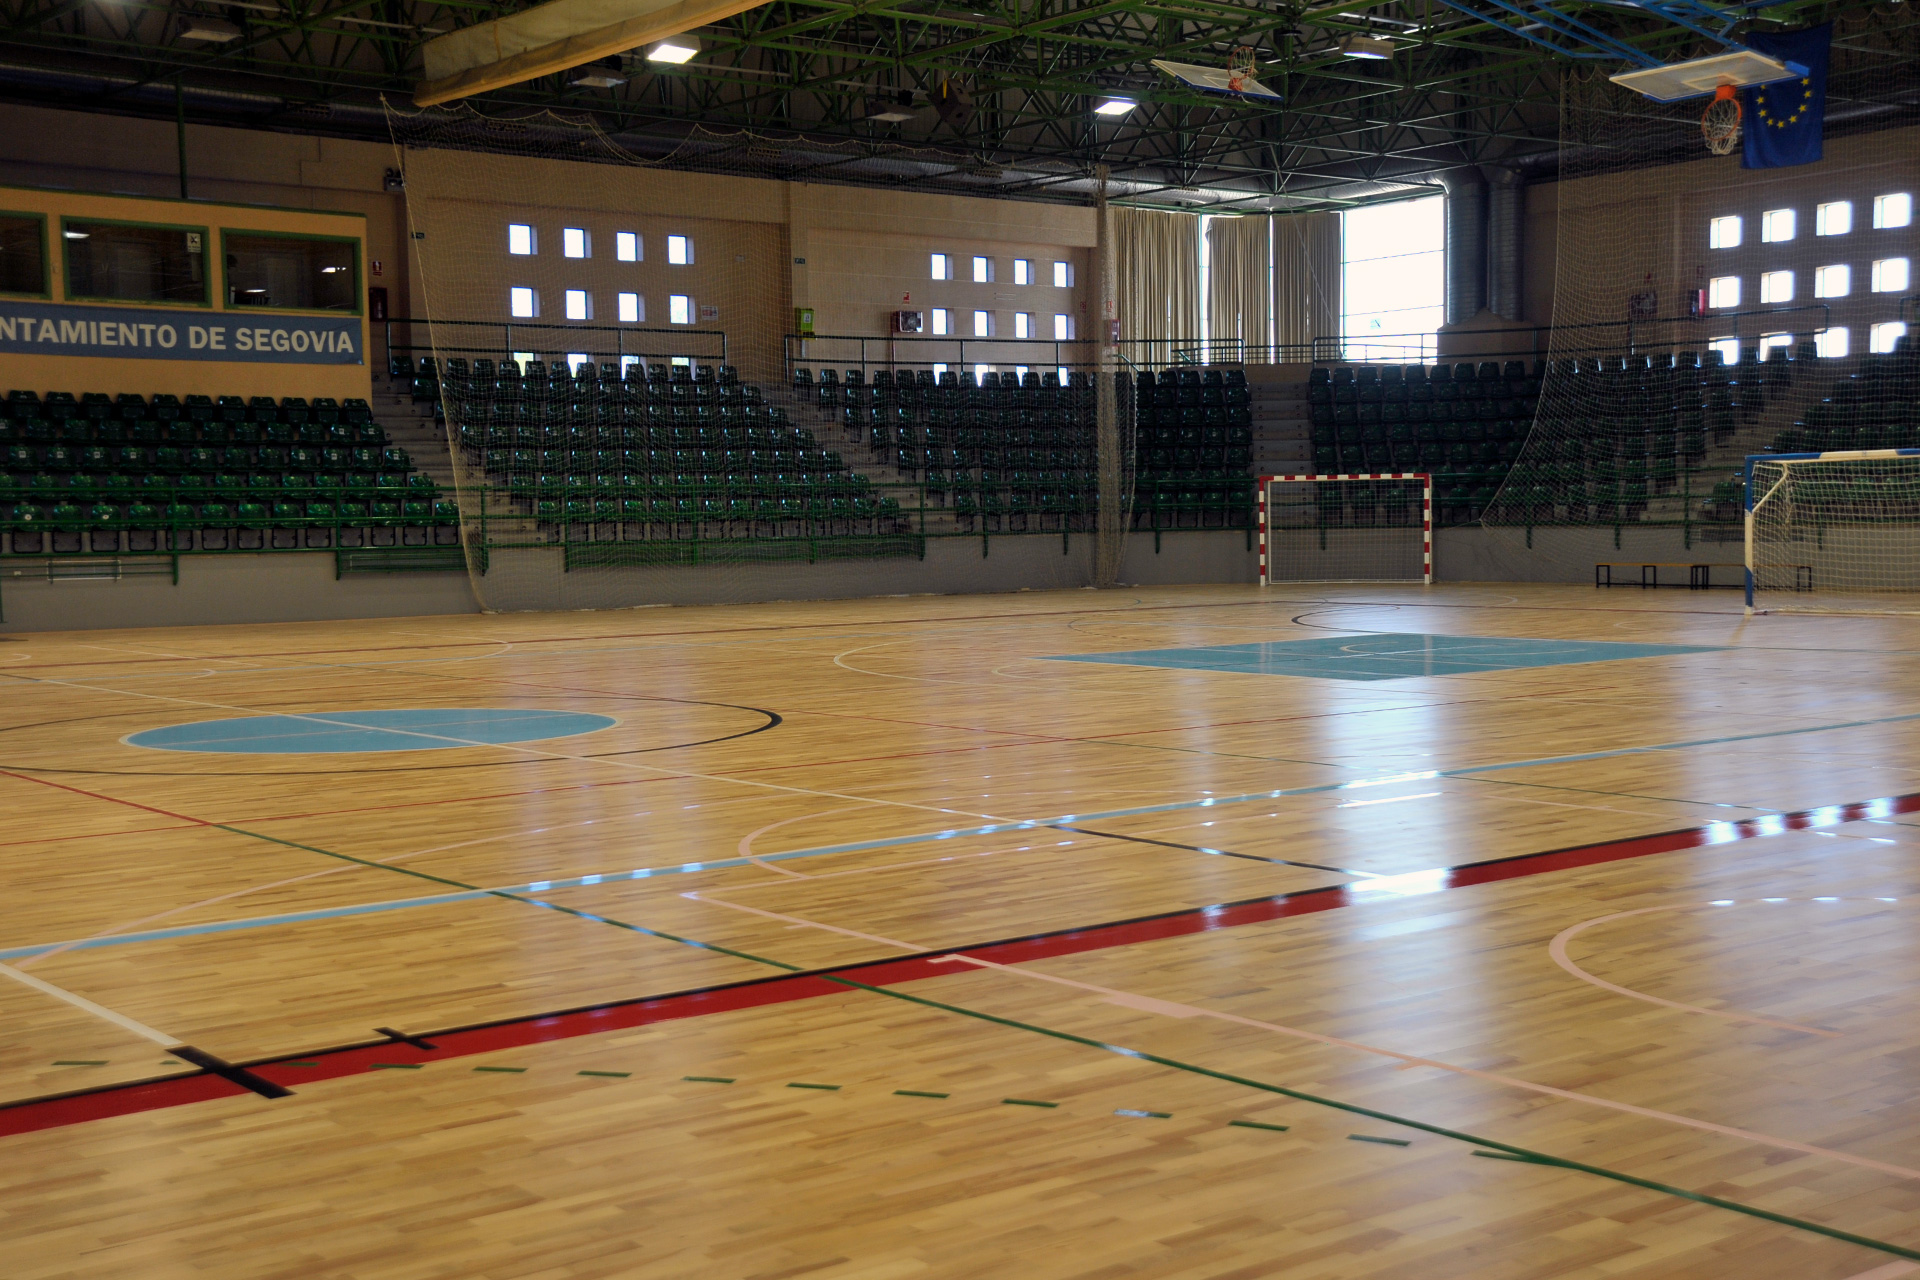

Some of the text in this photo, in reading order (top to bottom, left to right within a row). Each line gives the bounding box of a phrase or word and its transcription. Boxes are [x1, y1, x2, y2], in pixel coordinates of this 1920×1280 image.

[0, 316, 354, 353] NTAMIENTO DE SEGOVIA
